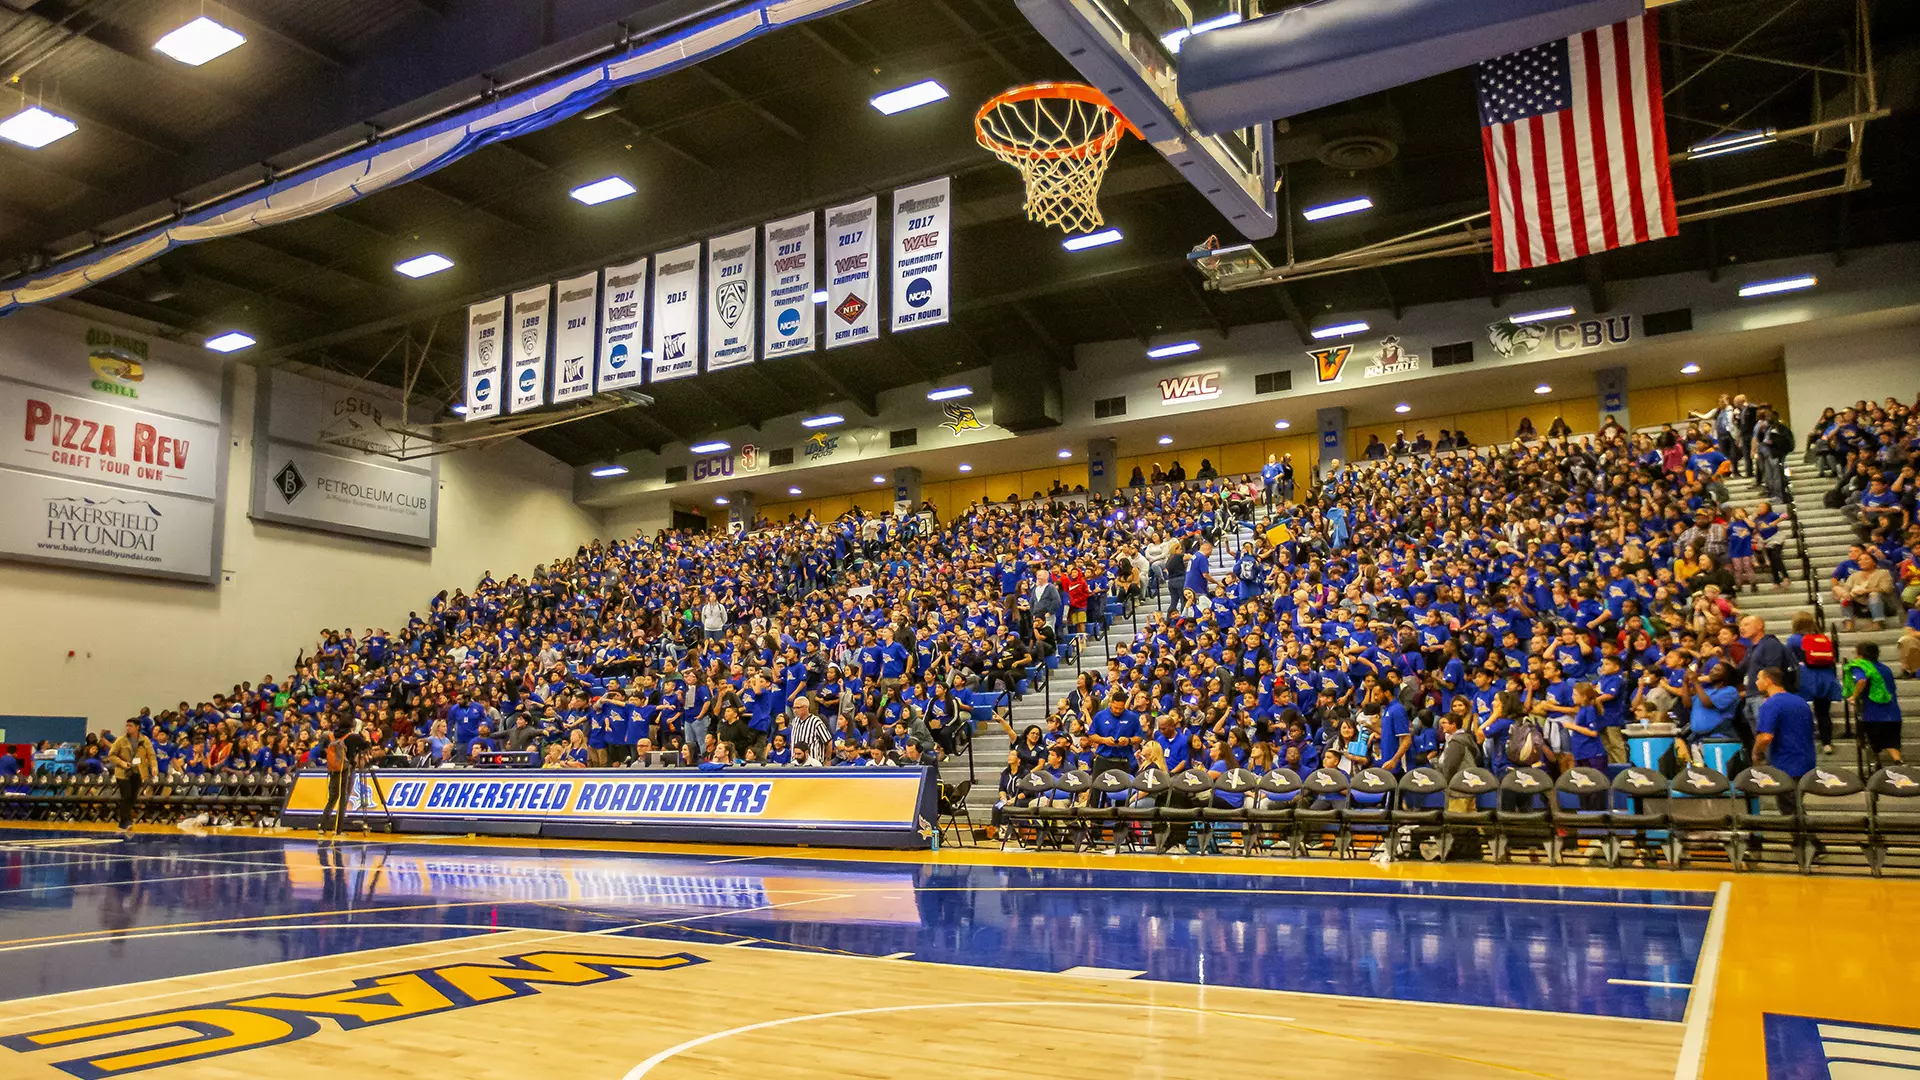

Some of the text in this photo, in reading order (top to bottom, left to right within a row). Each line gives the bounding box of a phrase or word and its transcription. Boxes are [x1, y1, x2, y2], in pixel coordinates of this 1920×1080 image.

[908, 215, 935, 231] 2017
[839, 231, 863, 247] 2017
[902, 231, 939, 252] WAC
[778, 241, 801, 256] 2016
[774, 253, 806, 273] WAC
[835, 253, 869, 274] WAC
[898, 251, 943, 268] TOURNAMENT
[721, 263, 743, 277] 2016
[833, 271, 869, 285] CHAMPIONS
[902, 264, 937, 278] CHAMPION
[781, 274, 800, 285] MEN'S
[614, 290, 635, 303] 2014
[667, 290, 687, 304] 2015
[771, 282, 809, 297] TOURNAMENT
[908, 289, 932, 302] NCAA
[774, 294, 805, 307] CHAMPION
[608, 302, 638, 321] WAC
[726, 305, 737, 319] 12
[843, 304, 860, 314] NIT
[898, 308, 941, 324] FIRST ROUND
[567, 316, 586, 330] 2014
[835, 326, 869, 340] SEMI FINAL
[1552, 315, 1631, 352] CBU
[771, 337, 808, 350] FIRST ROUND
[656, 360, 693, 373] FIRST ROUND
[1384, 358, 1419, 376] STATE
[91, 380, 139, 399] GRILL
[558, 387, 571, 396] FIRST
[1157, 371, 1222, 402] WAC
[334, 397, 382, 427] CSUB
[24, 399, 190, 470] PIZZA REV
[51, 450, 163, 481] CRAFT YOUR OWN
[693, 454, 735, 482] GCU
[317, 477, 427, 510] PETROLEUM CLUB
[48, 502, 159, 532] BAKERSFIELD
[47, 520, 156, 551] HYUNDAI
[37, 542, 162, 563] www.bakersfieldhyundai.com
[387, 782, 770, 814] CSU BAKERSFIELD ROADRUNNERS
